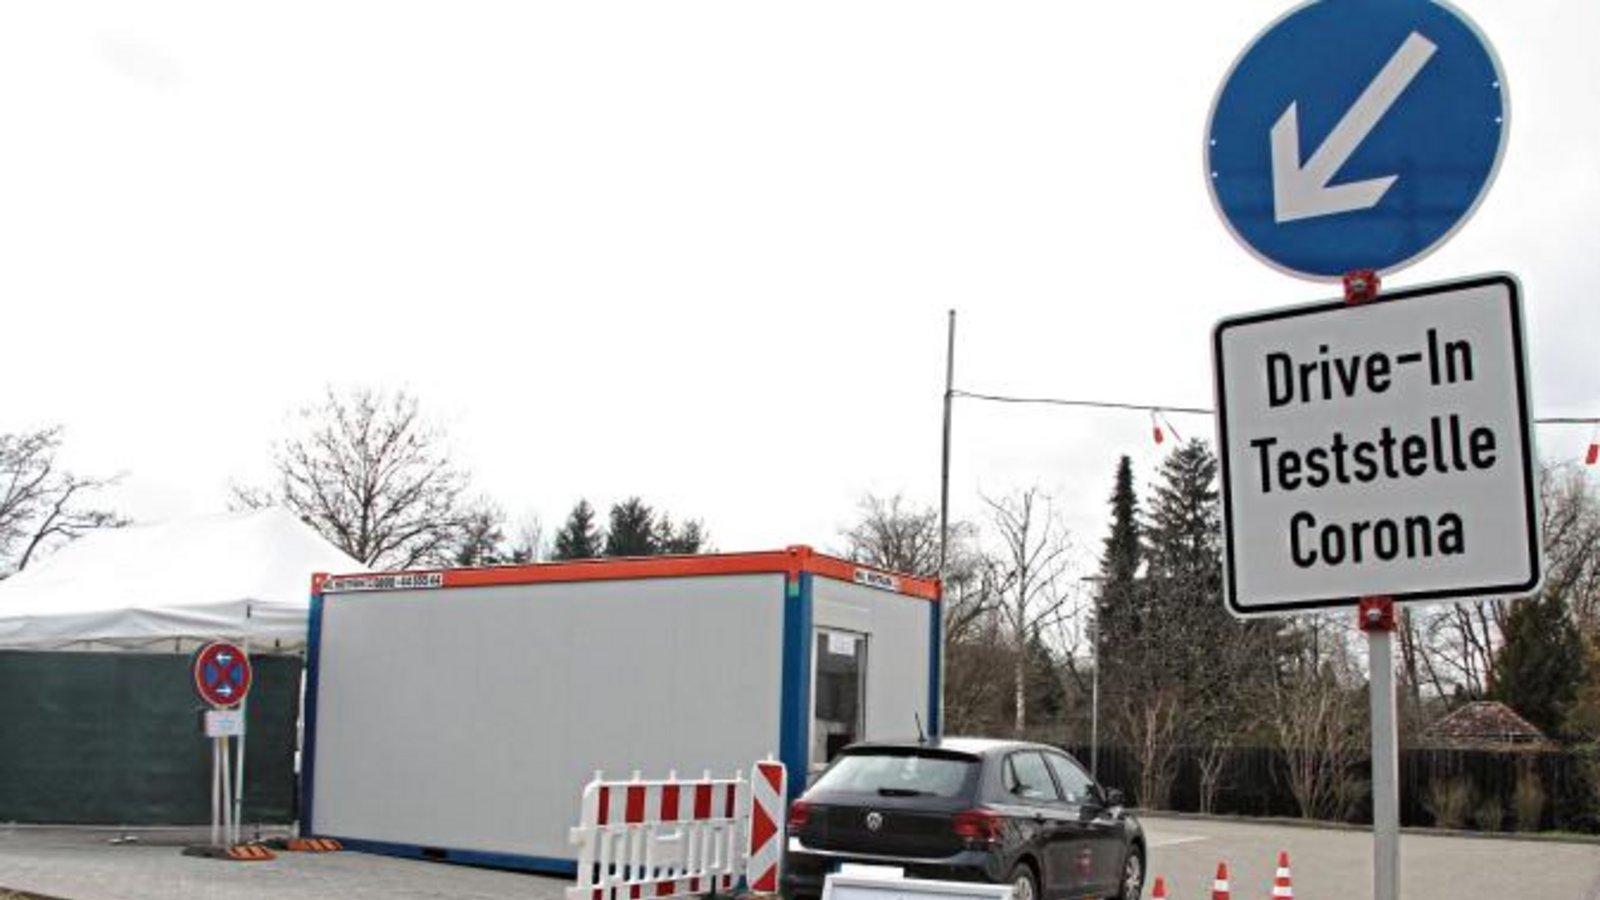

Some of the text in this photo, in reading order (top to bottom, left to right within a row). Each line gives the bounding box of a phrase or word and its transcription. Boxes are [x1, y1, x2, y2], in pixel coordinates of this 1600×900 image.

[1266, 329, 1474, 408] Drive-In
[1250, 414, 1497, 494] Teststelle
[1290, 511, 1465, 569] Corona
